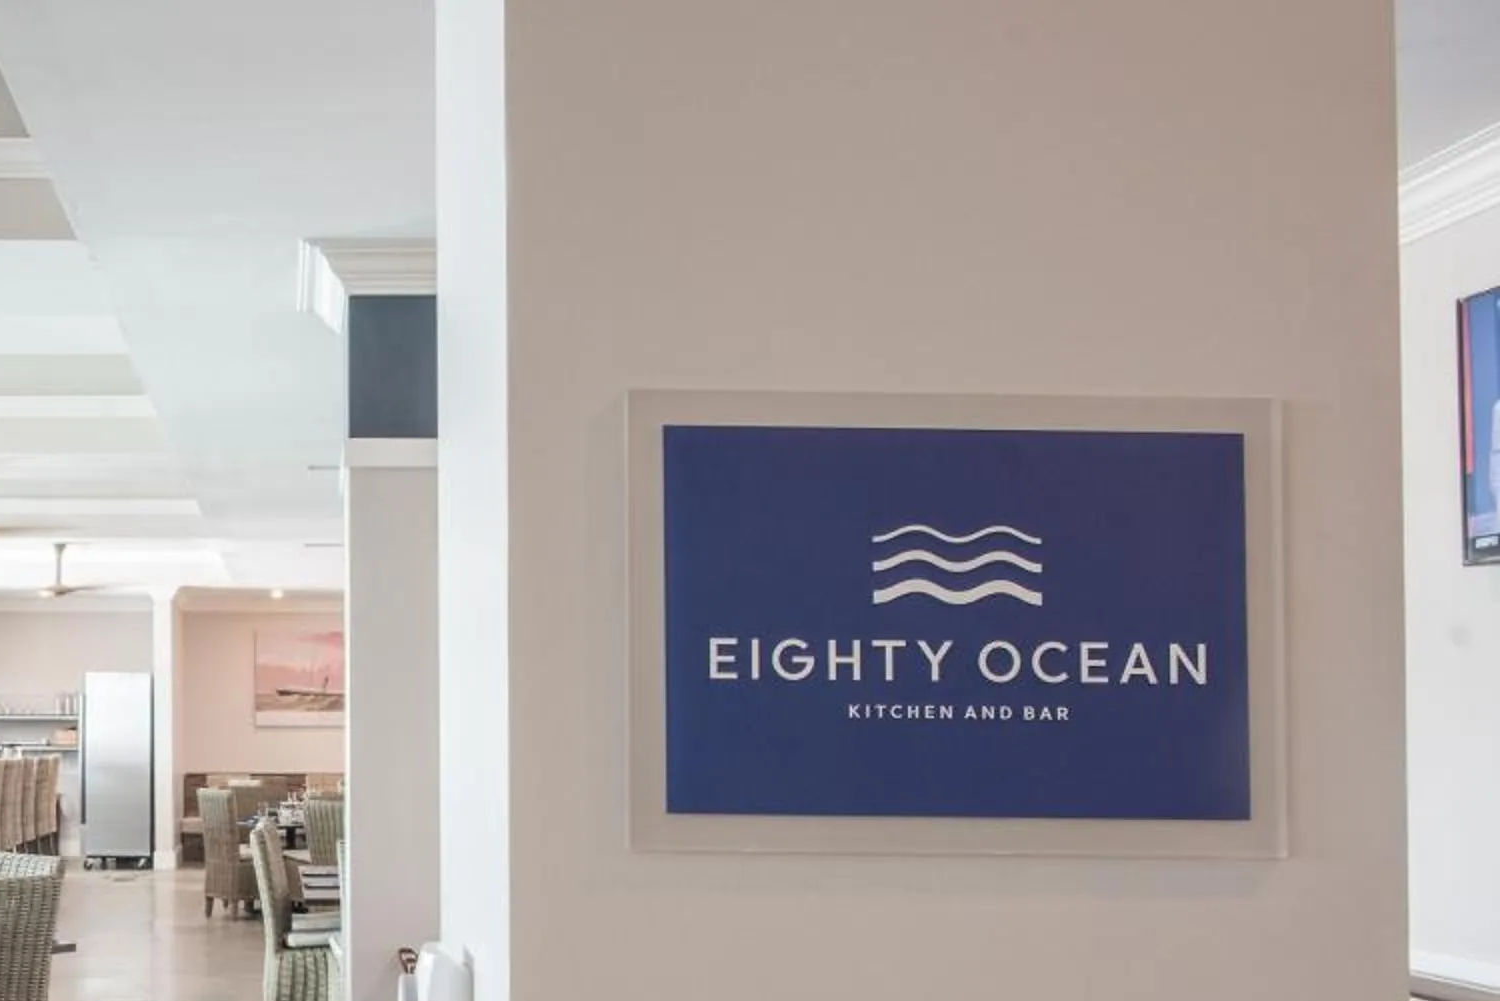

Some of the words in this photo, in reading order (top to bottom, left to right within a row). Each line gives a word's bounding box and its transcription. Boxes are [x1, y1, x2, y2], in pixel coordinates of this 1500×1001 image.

[708, 636, 954, 682] EIGHTY
[977, 640, 1208, 686] OCEAN
[847, 703, 954, 720] KITCHEN
[963, 704, 1014, 721] AND
[1022, 705, 1070, 722] BAR
